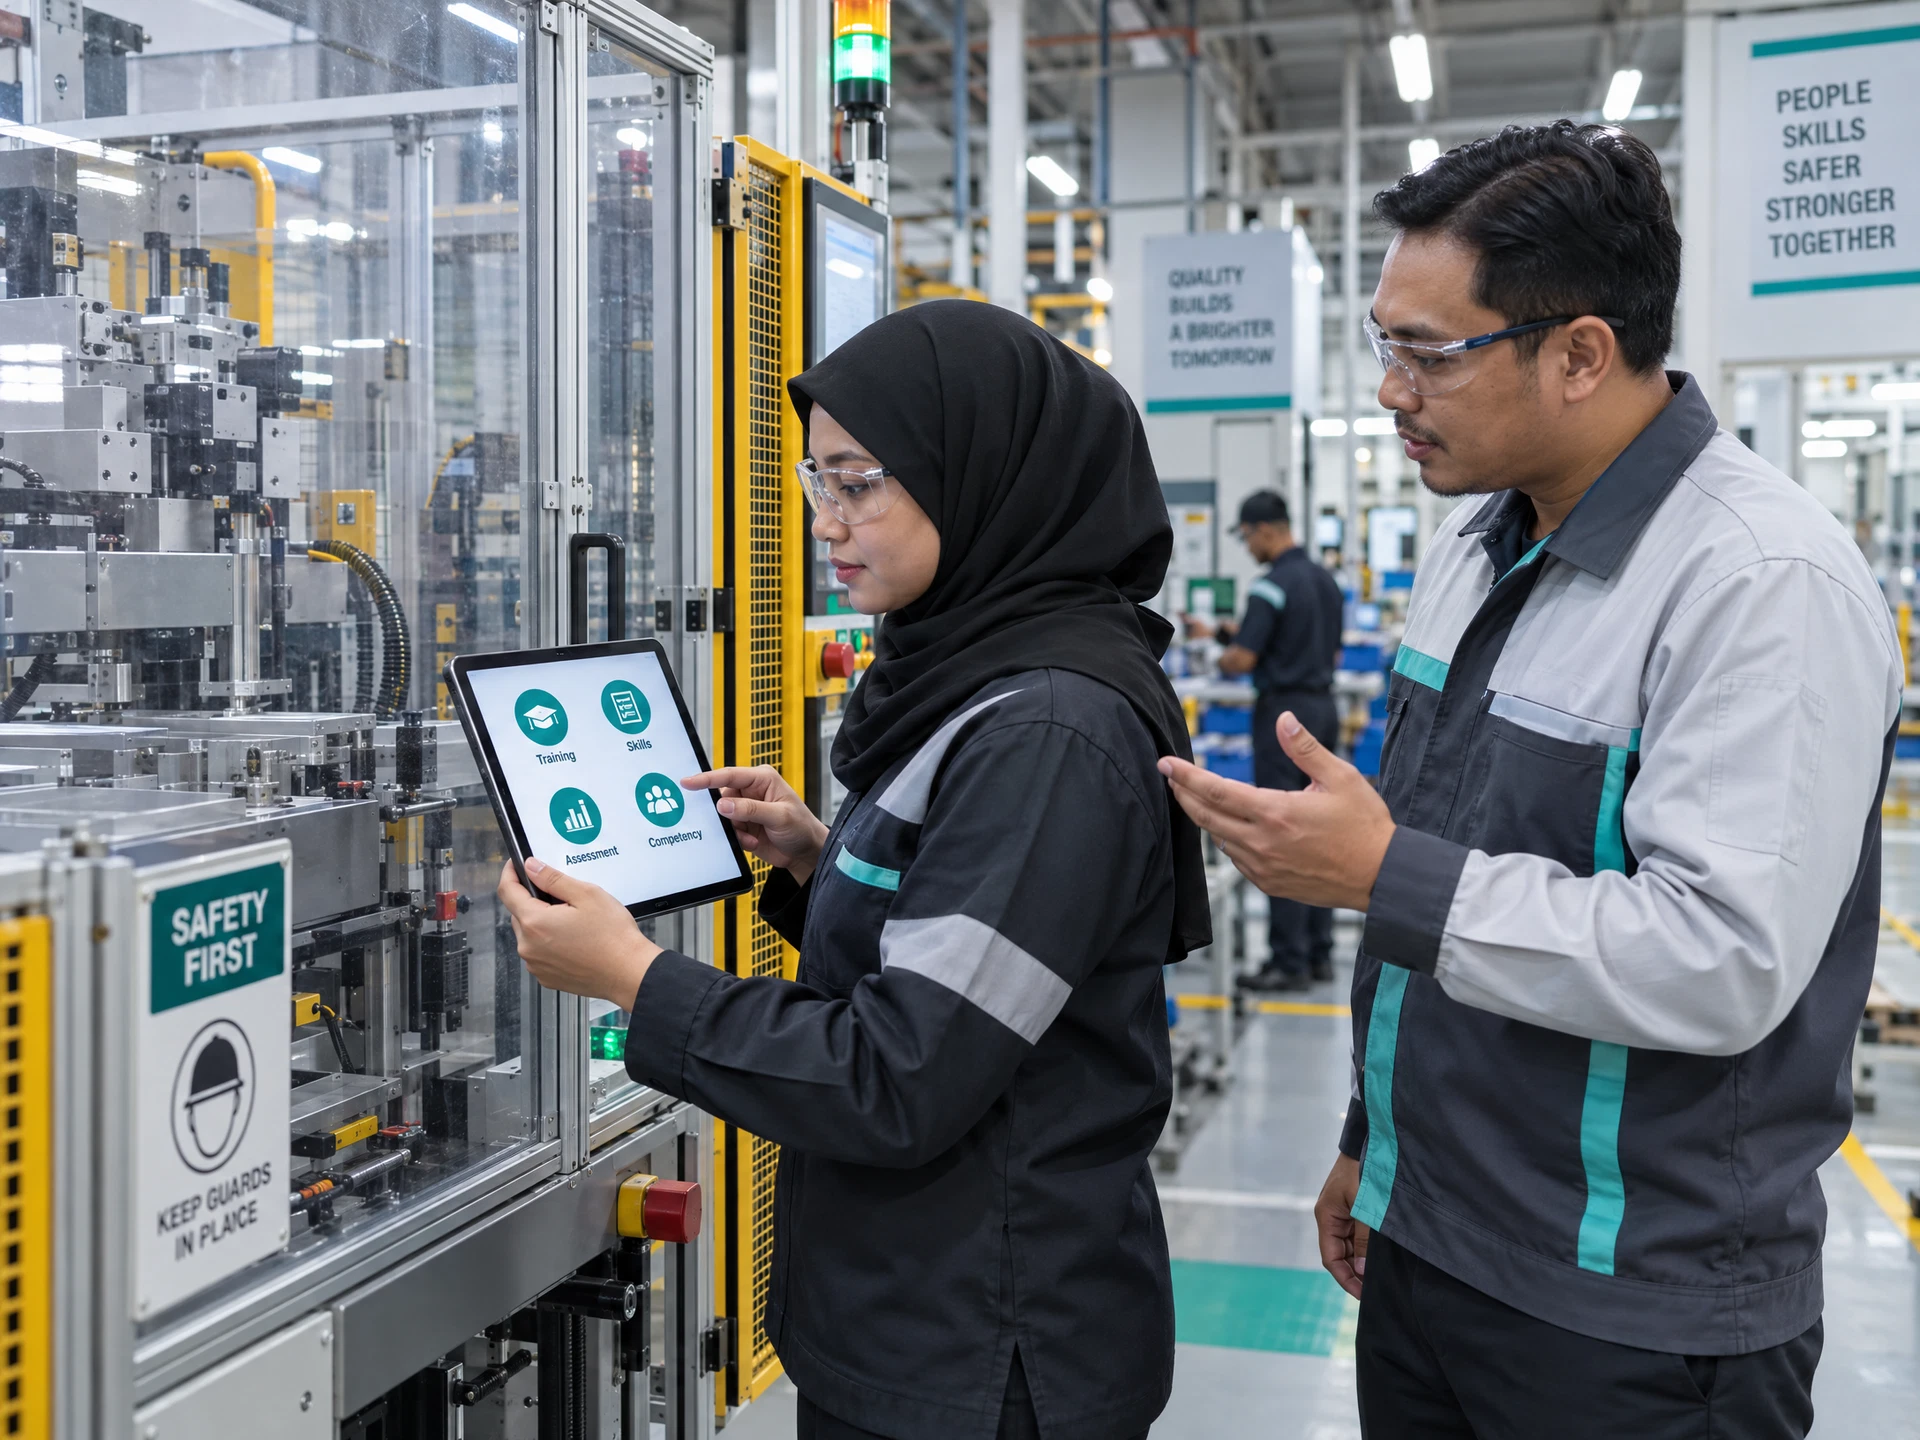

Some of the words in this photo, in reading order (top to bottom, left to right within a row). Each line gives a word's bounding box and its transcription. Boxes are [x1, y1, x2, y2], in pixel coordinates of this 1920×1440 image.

[1776, 80, 1871, 113] PEOPLE
[1783, 117, 1865, 148] SKILLS
[1783, 154, 1860, 184] SAFER
[1766, 188, 1894, 222] STRONGER
[1769, 224, 1895, 258] TOGETHER
[1168, 265, 1245, 288] QUALITY
[1169, 293, 1233, 315] BUILDS
[1169, 323, 1182, 341] A
[1187, 318, 1275, 342] BRIGHTER
[1170, 347, 1275, 369] TOMORROW
[536, 749, 577, 766] Training
[626, 739, 653, 753] Skills
[648, 828, 703, 849] Competency
[565, 845, 619, 866] Assessment
[171, 888, 269, 946] SAFETY
[184, 932, 258, 988] FIRST
[157, 1194, 202, 1236] KEEP
[207, 1161, 271, 1211] GUARDS
[174, 1229, 194, 1261] IN
